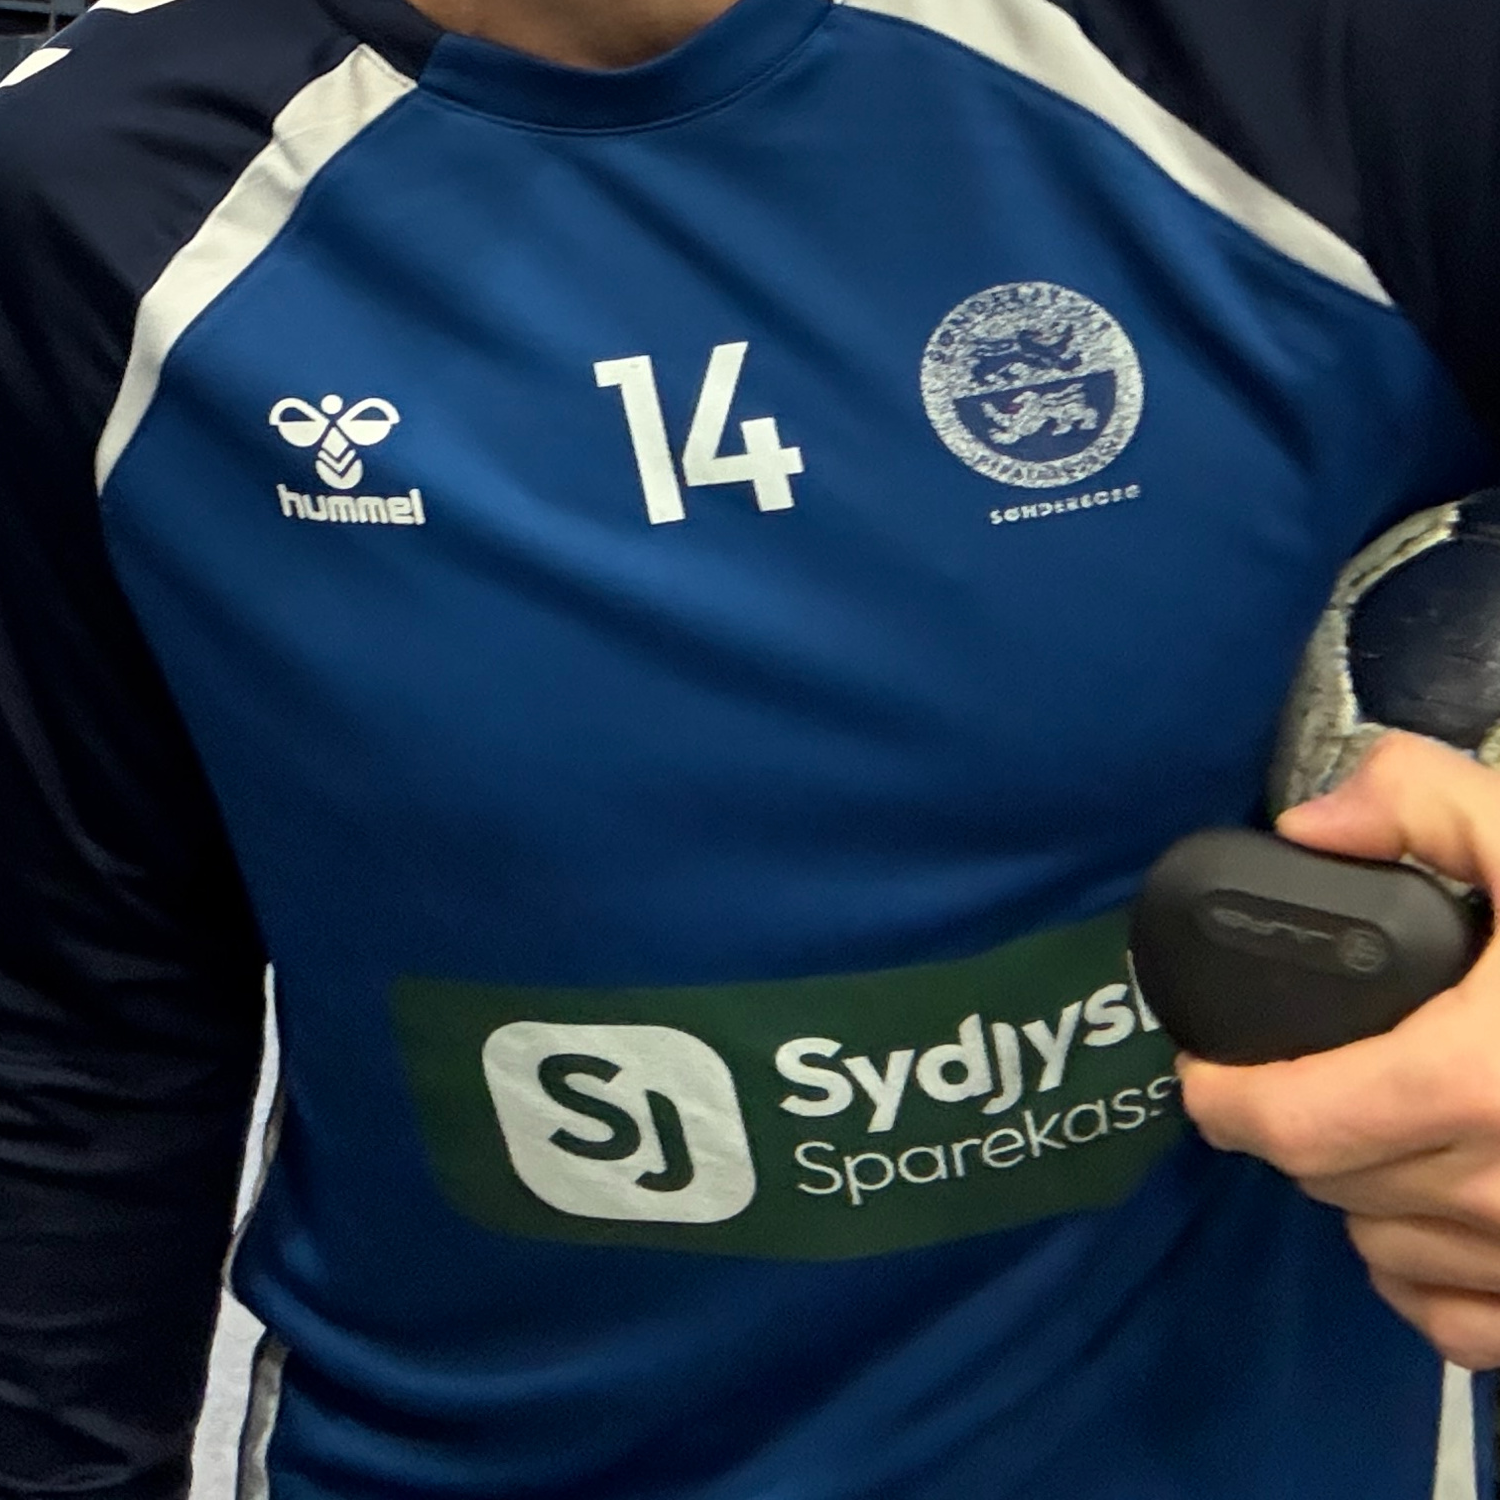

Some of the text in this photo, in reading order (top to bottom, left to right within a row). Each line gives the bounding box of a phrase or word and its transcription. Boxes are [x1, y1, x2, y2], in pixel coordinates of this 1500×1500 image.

[593, 340, 805, 525] 14
[276, 483, 426, 525] hummel
[774, 948, 1161, 1133] Sydjys
[536, 1052, 694, 1193] SJ
[794, 1074, 1181, 1206] Sparekass
